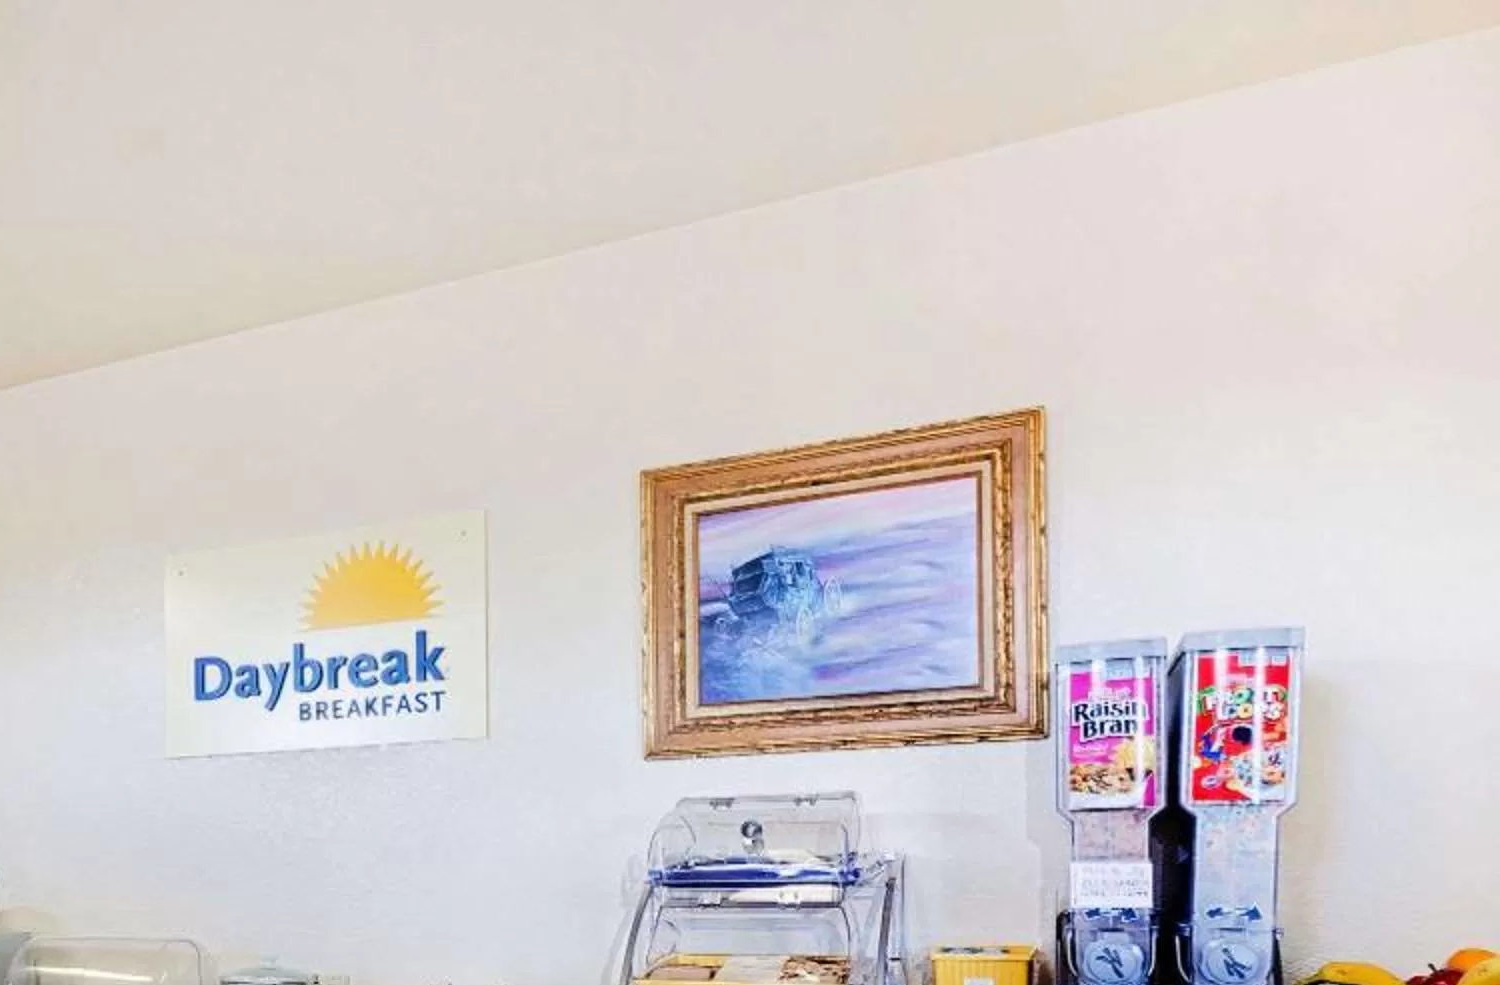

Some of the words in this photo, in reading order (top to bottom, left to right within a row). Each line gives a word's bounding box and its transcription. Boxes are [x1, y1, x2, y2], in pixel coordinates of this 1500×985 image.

[193, 629, 447, 712] Daybreak
[298, 690, 447, 722] BREAKFAST
[1073, 701, 1147, 723] Raisin
[1083, 718, 1140, 739] Bran
